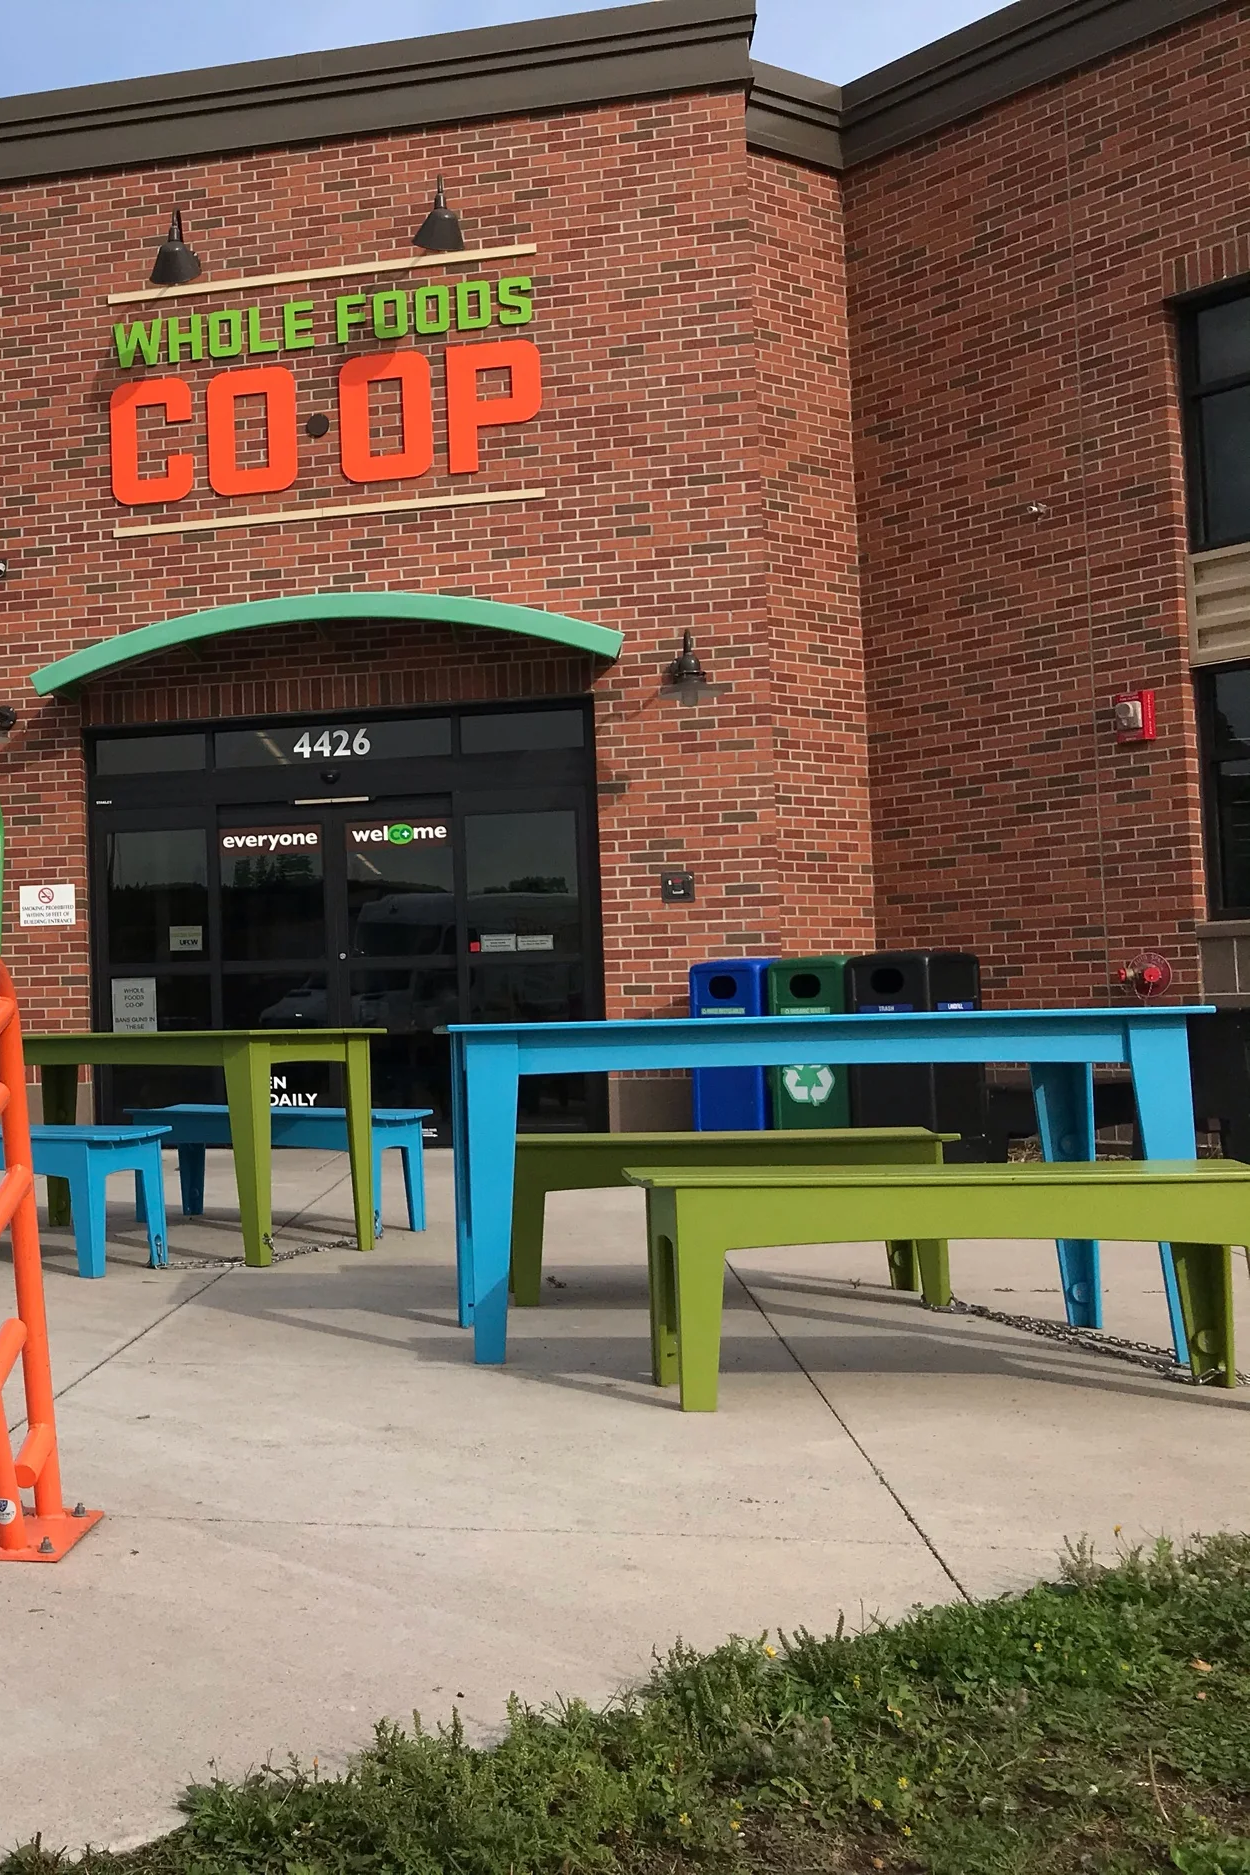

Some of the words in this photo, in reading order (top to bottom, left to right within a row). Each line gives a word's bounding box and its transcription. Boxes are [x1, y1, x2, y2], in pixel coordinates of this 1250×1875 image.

[113, 299, 316, 370] WHOLE
[335, 275, 534, 345] FOODS
[293, 727, 371, 759] 4426
[222, 832, 318, 852] everyone
[269, 1092, 318, 1107] DAILY
